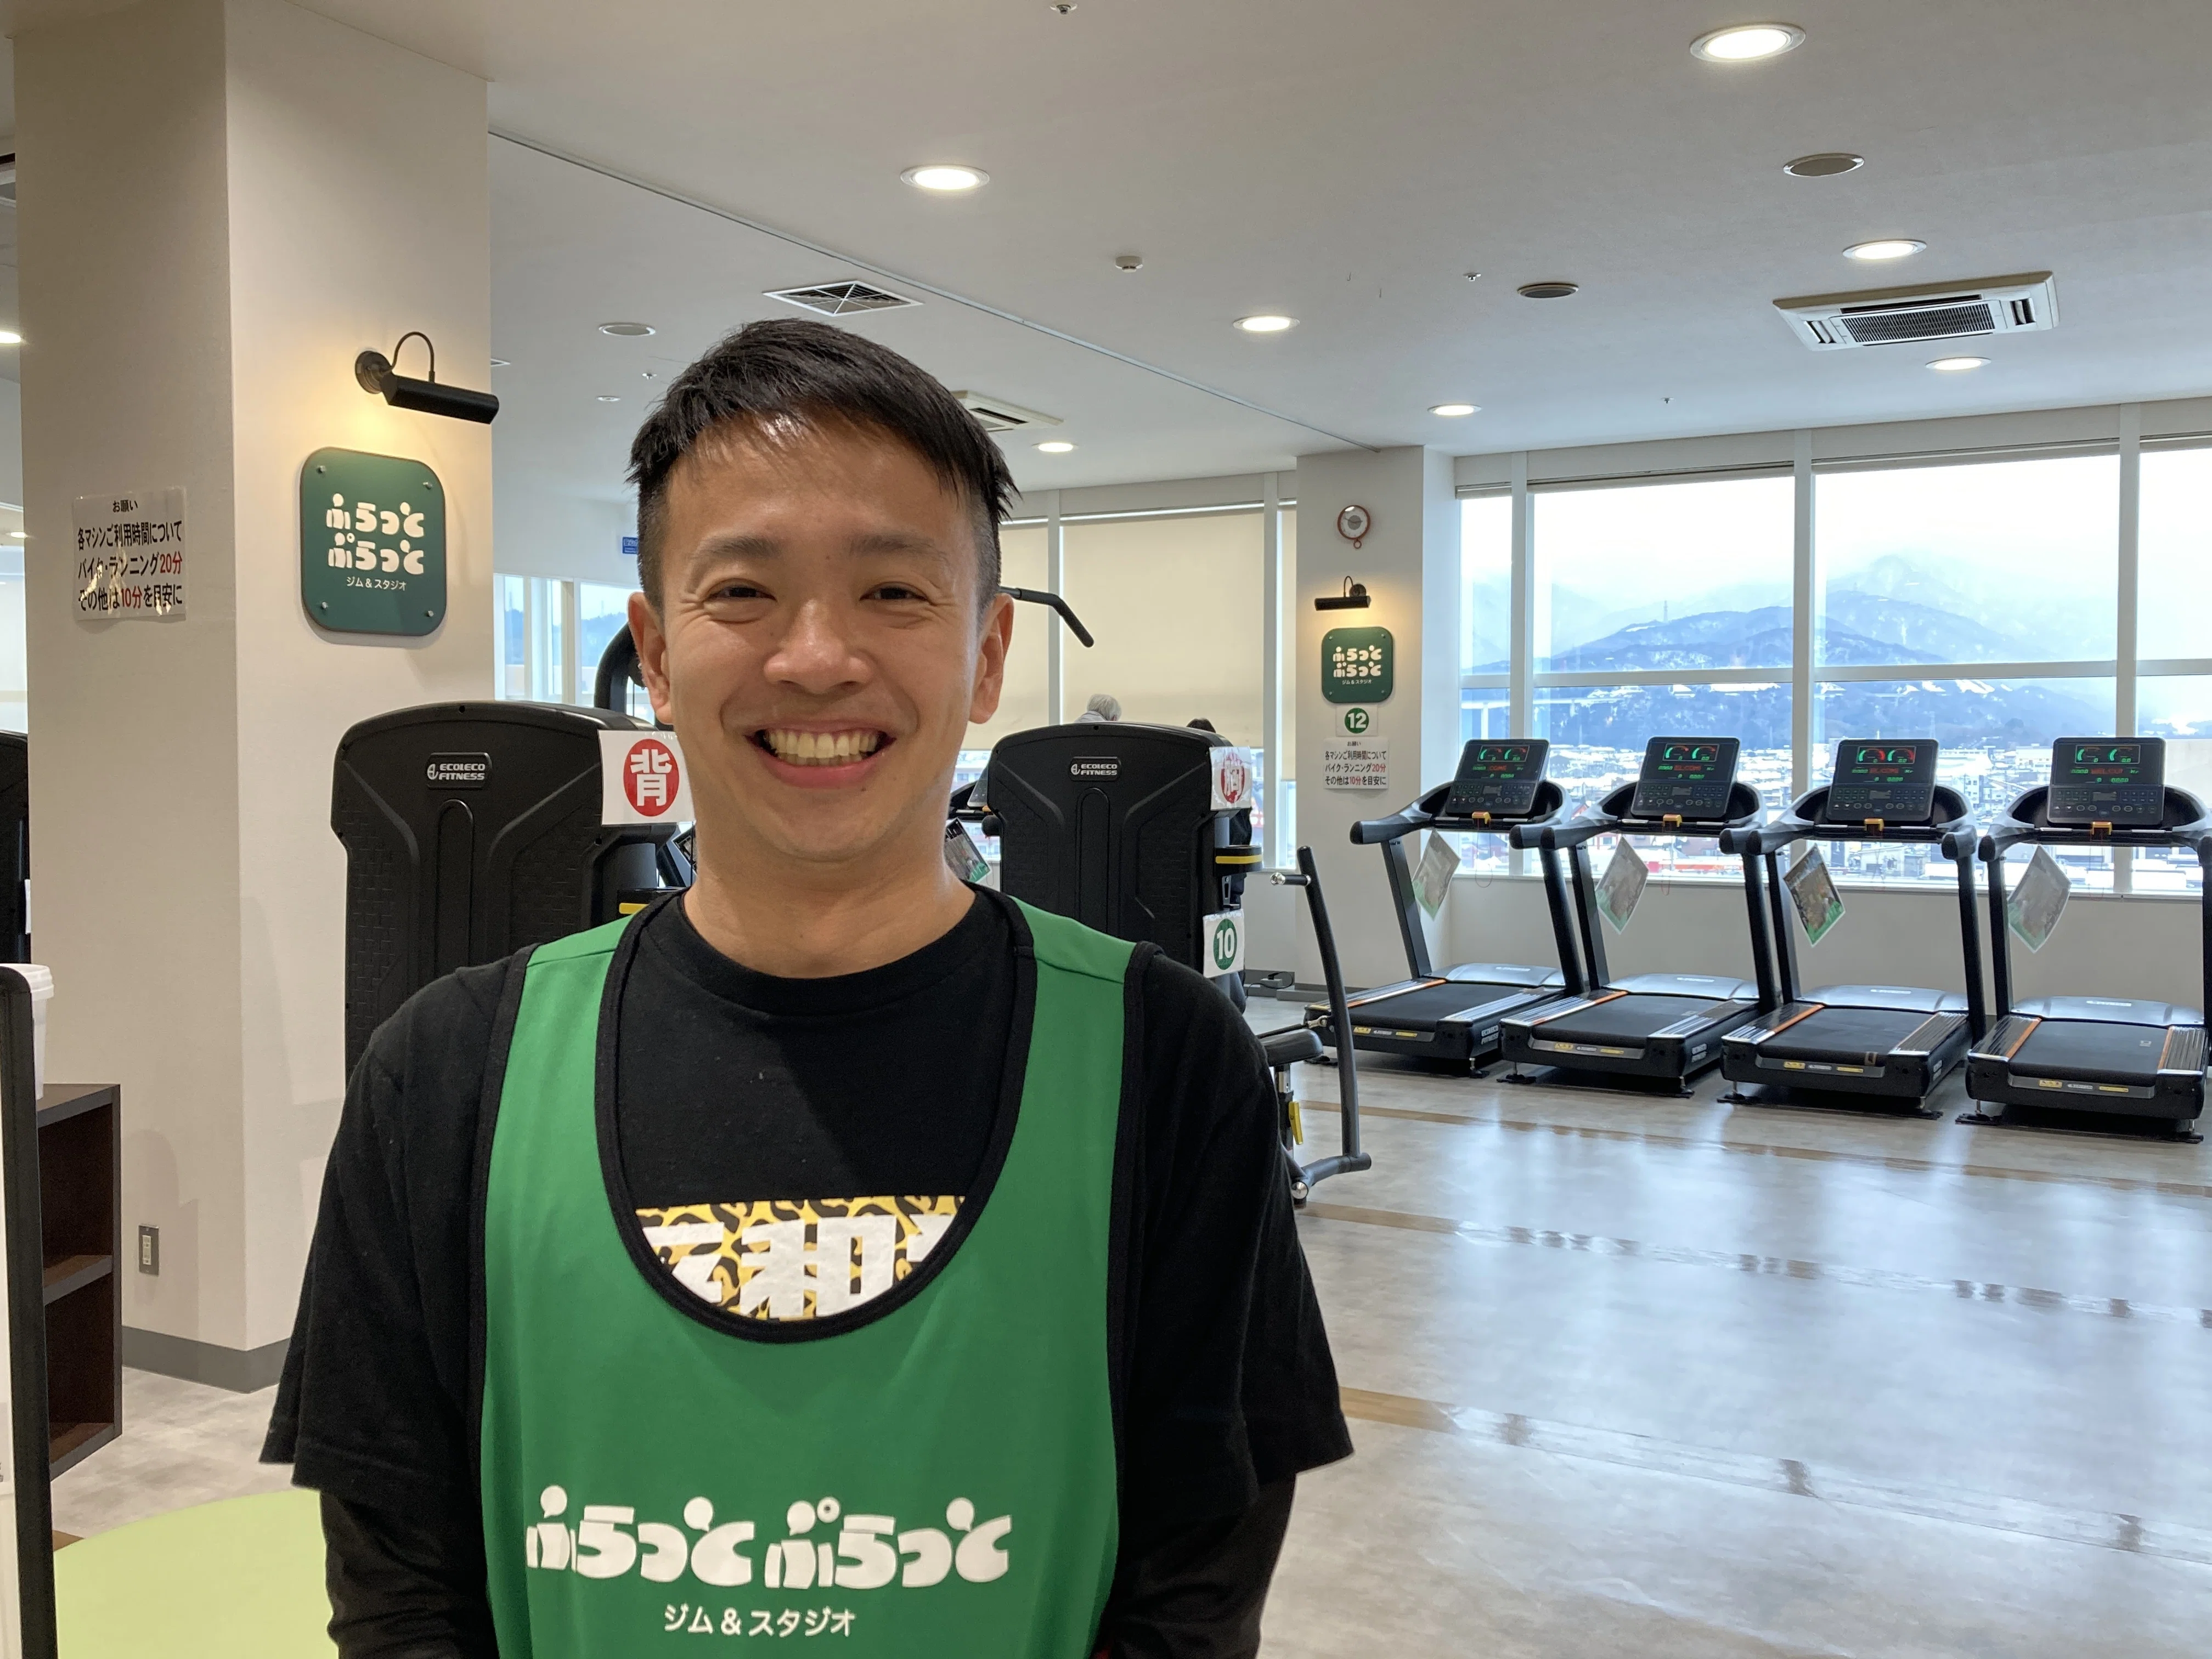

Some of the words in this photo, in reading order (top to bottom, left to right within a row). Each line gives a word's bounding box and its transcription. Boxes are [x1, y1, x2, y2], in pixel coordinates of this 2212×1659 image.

[112, 499, 138, 512] お願い
[326, 493, 425, 538] ふらっと
[78, 520, 182, 551] 各マシンご利用時間について
[328, 532, 424, 574] ぷらっと
[1348, 712, 1367, 729] 12
[630, 748, 672, 806] 背
[1216, 927, 1235, 960] 10
